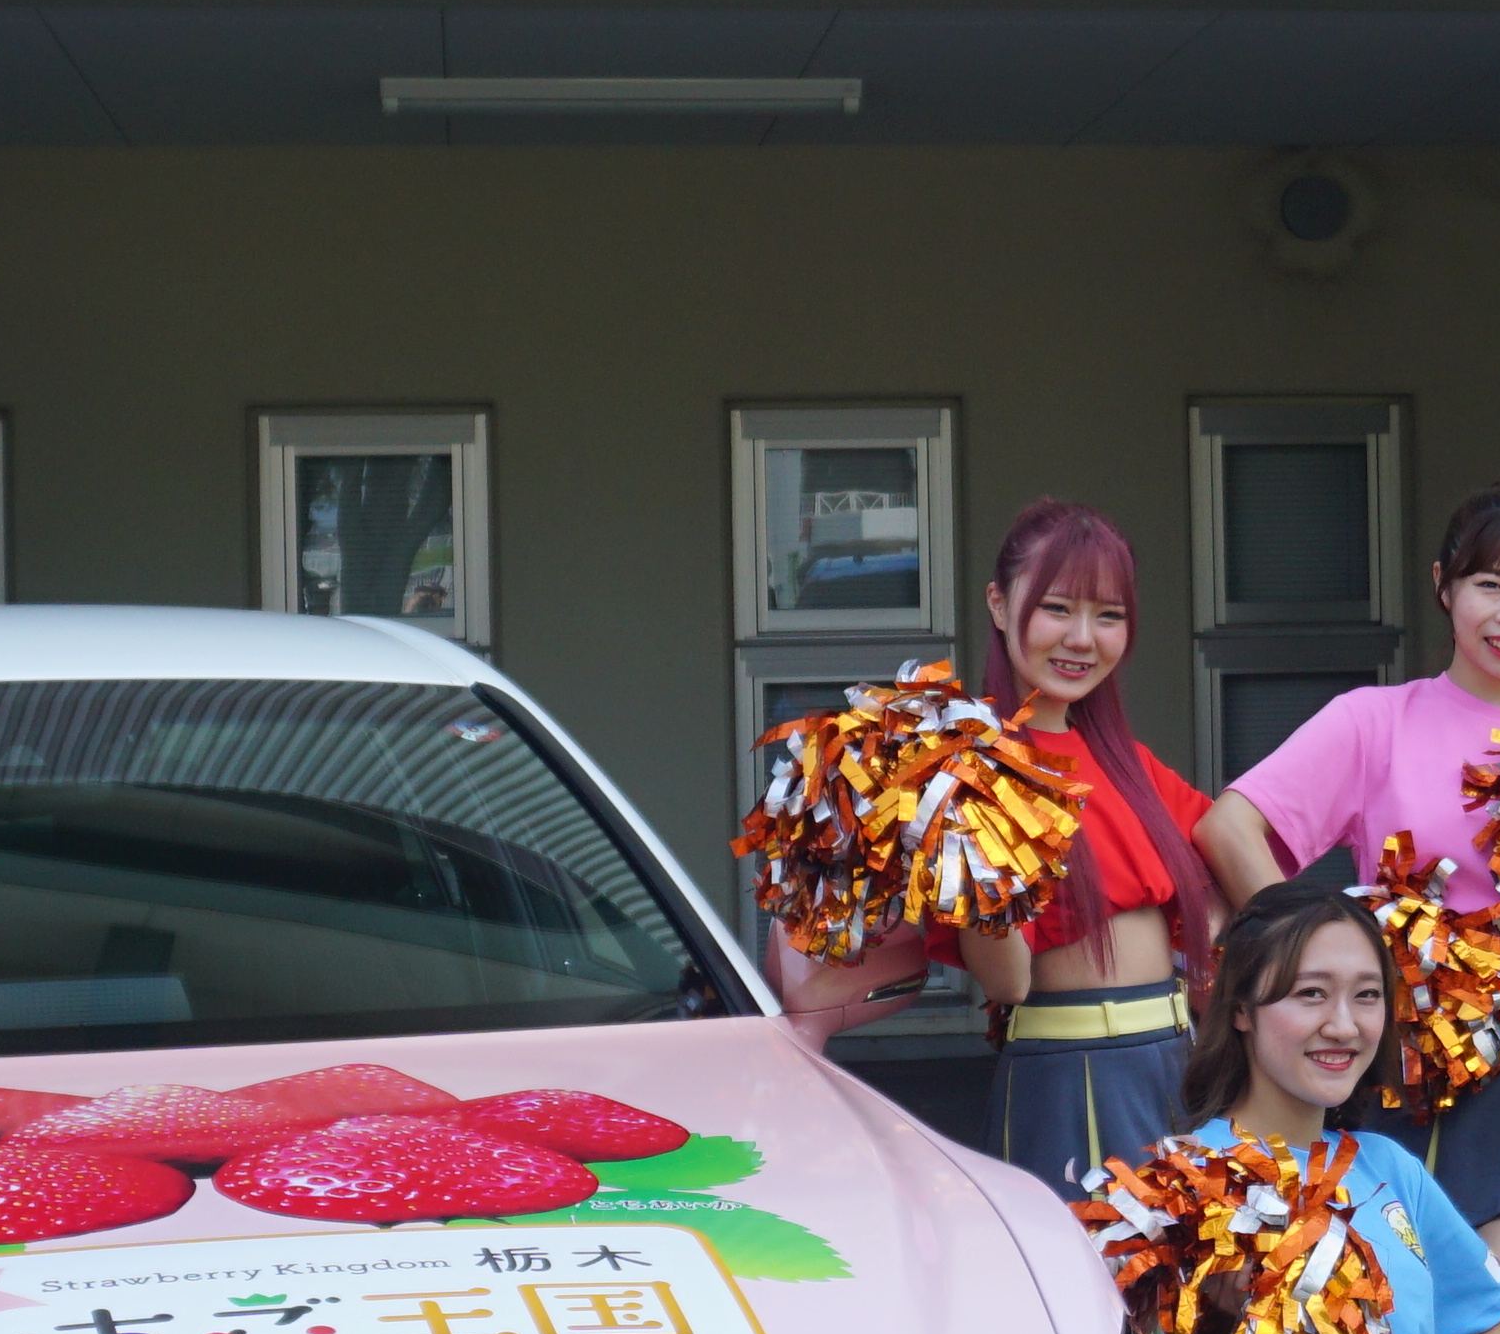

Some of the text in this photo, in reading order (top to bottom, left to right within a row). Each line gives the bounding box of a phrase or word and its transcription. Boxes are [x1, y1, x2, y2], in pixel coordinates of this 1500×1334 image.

[589, 1198, 744, 1213] とちあいか
[40, 1244, 654, 1294] Strawberry Kingdom 栃木
